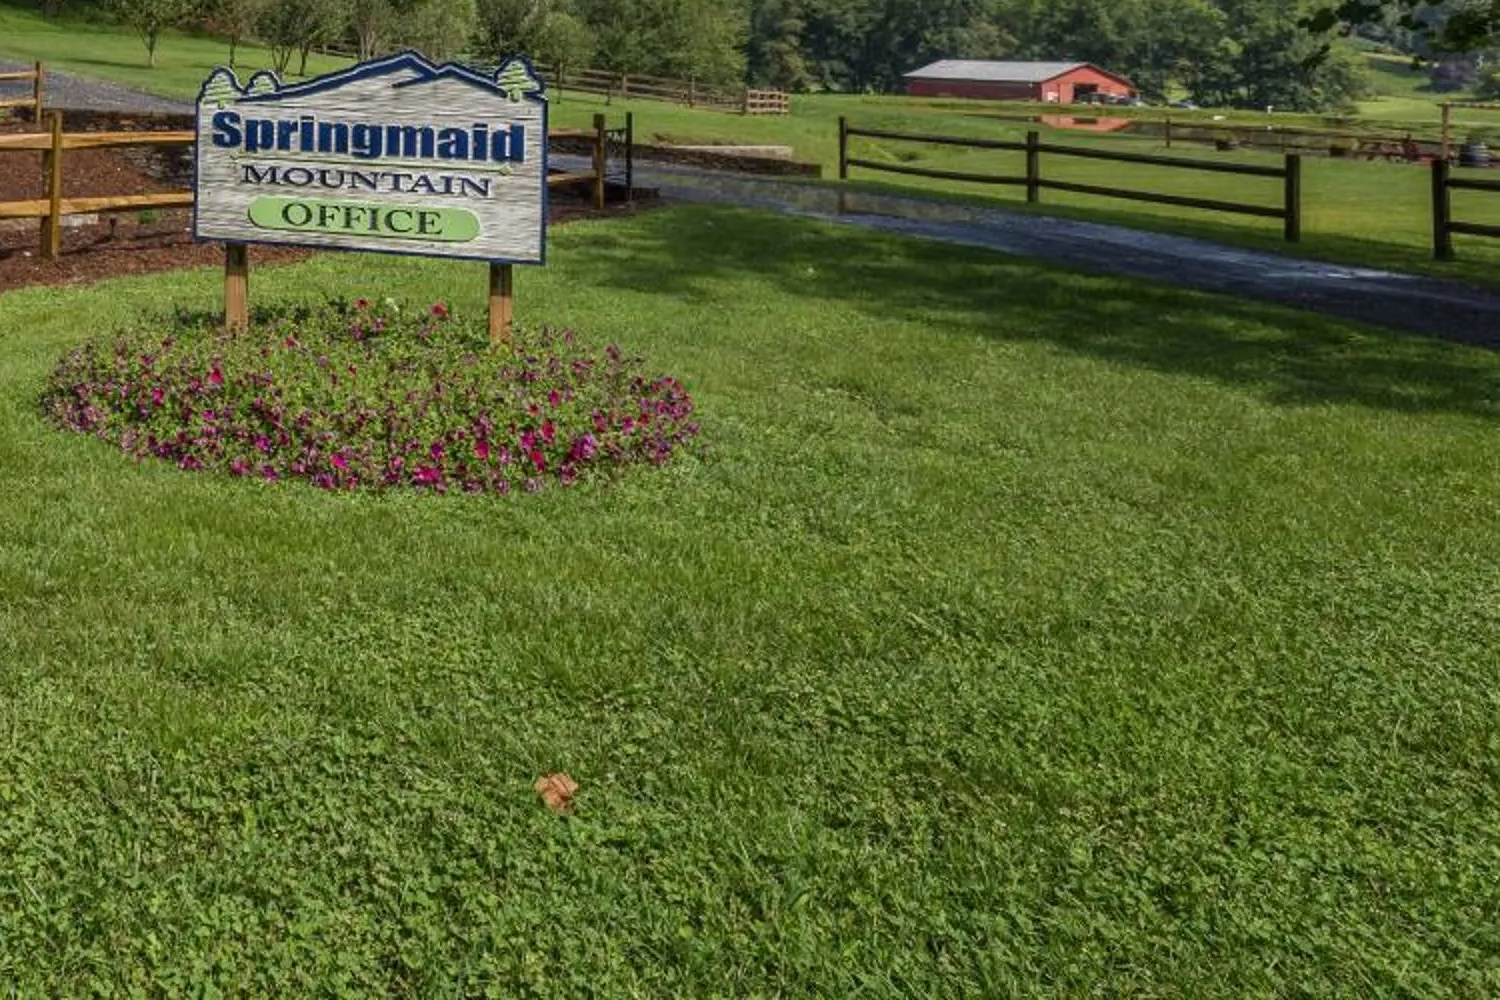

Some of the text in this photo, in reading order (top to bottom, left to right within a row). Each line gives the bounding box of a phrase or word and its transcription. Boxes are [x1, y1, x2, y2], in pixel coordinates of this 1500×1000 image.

[212, 111, 525, 163] Springmaid
[241, 164, 491, 197] MOUNTAIN
[281, 203, 443, 235] OFFICE
